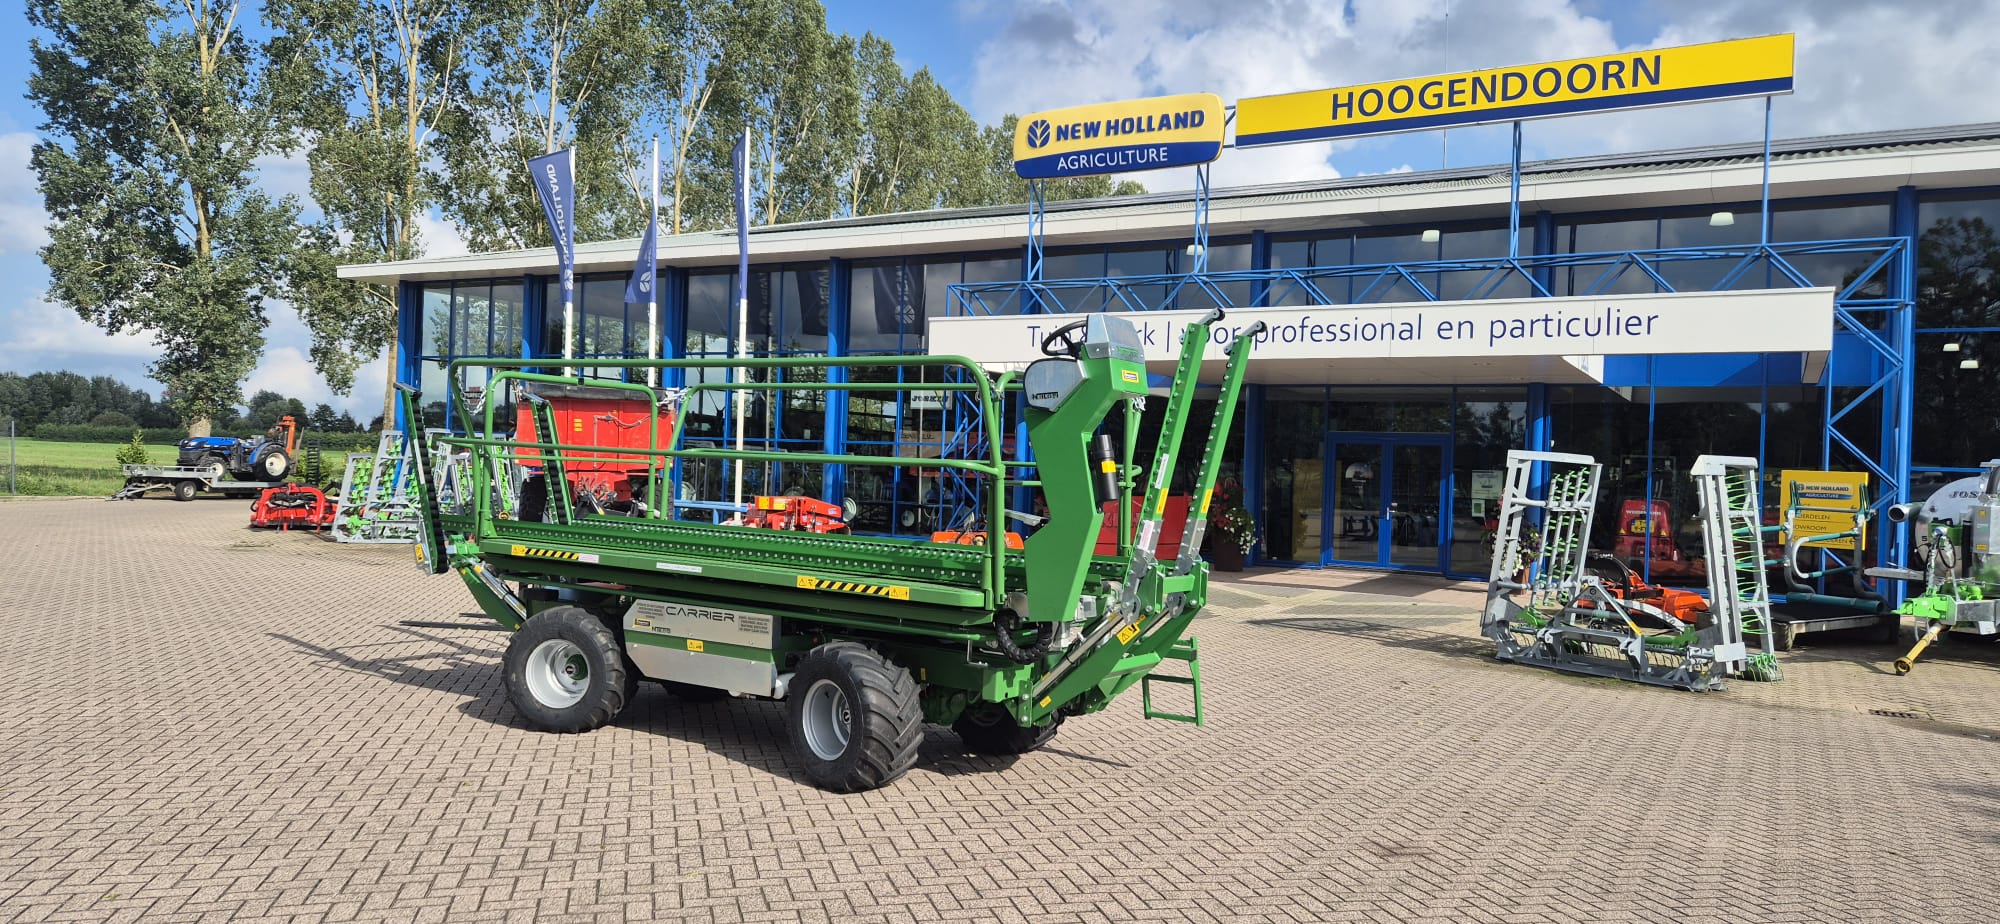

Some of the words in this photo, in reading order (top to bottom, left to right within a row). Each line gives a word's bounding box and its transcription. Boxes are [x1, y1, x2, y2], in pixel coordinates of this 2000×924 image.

[1331, 55, 1662, 121] HOOGENDOORN
[1056, 120, 1101, 142] NEW
[1106, 109, 1205, 137] HOLLAND
[1057, 147, 1168, 171] AGRICULTURE
[1254, 312, 1422, 351] professional
[1437, 319, 1474, 340] en
[1490, 307, 1659, 348] particulier
[665, 605, 735, 623] CARRIER
